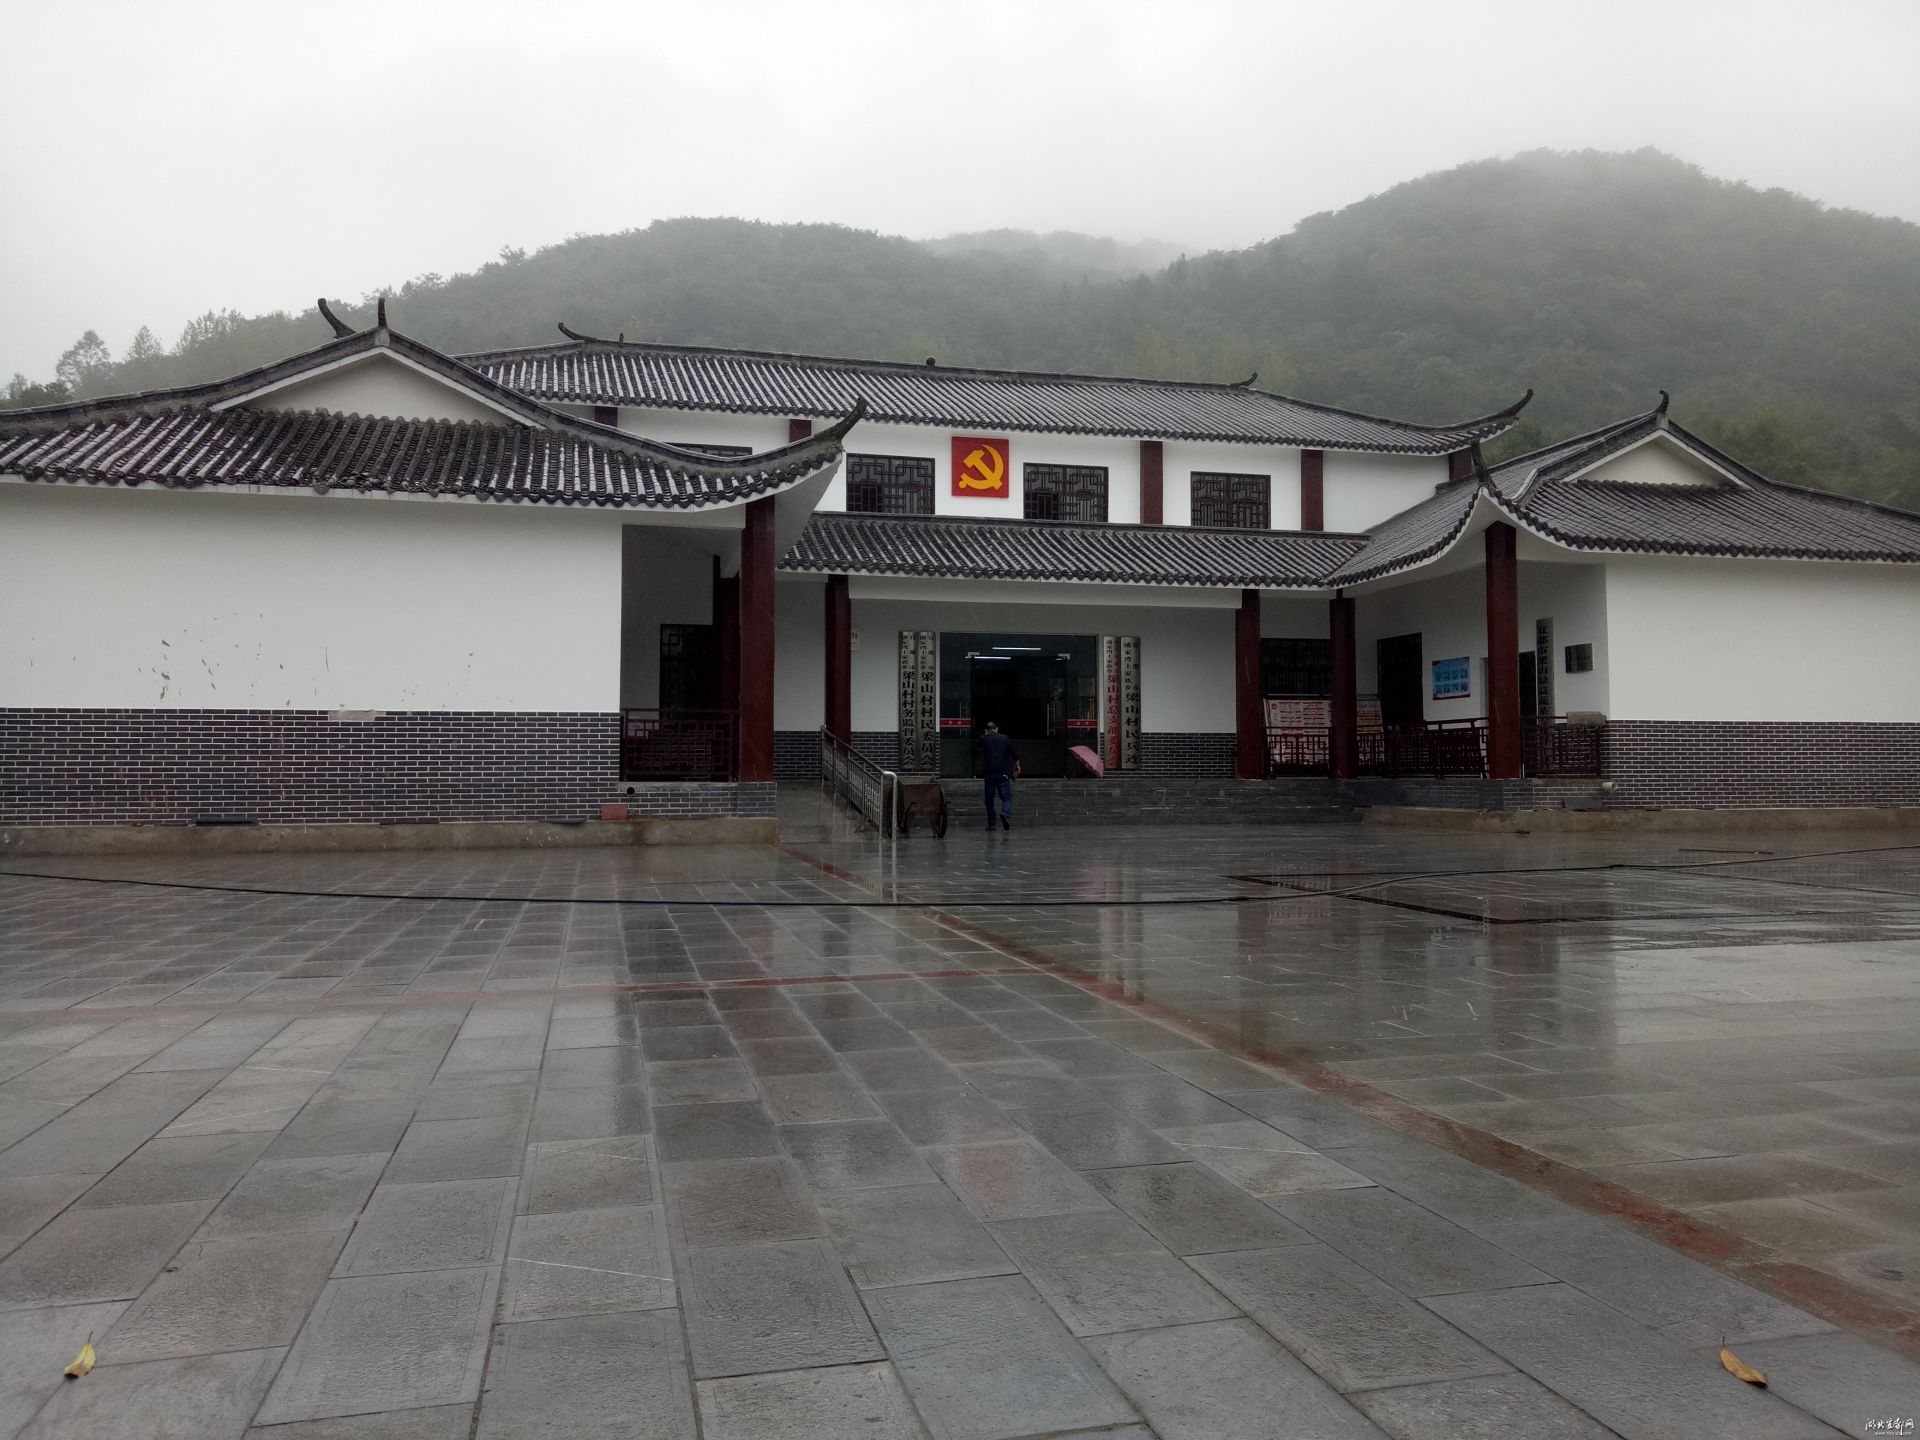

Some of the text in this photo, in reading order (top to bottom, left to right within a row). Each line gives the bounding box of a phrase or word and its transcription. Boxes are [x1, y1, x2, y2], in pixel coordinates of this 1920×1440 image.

[903, 670, 916, 765] 梁山村村务监督委员会
[920, 671, 934, 766] 梁山村村民委员会
[1125, 692, 1140, 764] 梁山村民兵连
